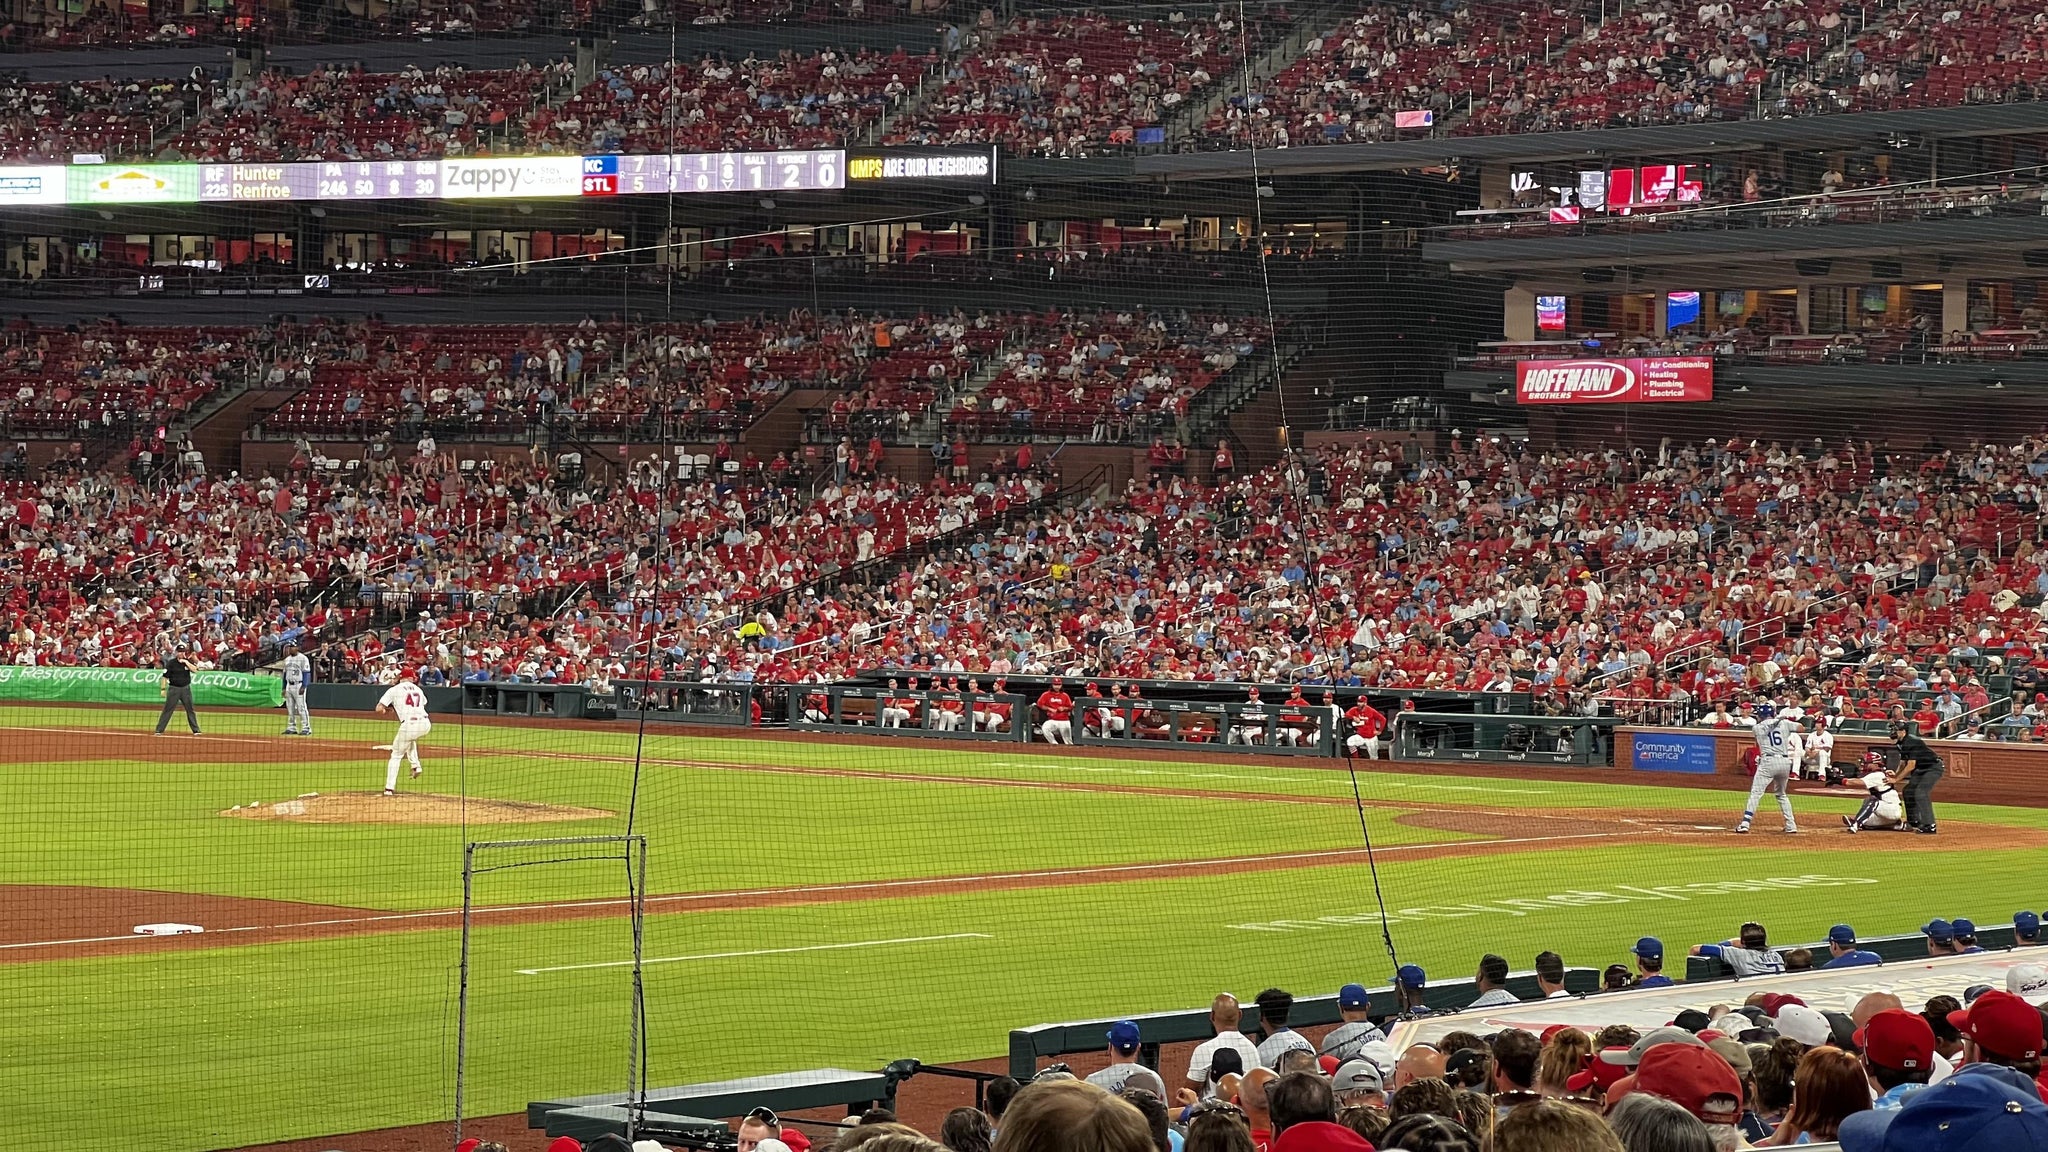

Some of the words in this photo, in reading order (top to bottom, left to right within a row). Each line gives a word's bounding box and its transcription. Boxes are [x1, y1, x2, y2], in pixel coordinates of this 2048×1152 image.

[584, 159, 603, 172] KC
[634, 156, 644, 172] 7
[664, 156, 681, 172] 11
[700, 156, 708, 171] 1
[744, 156, 766, 165] BALL
[777, 154, 807, 165] STRIKE
[818, 154, 836, 163] OUT
[206, 168, 224, 181] RF
[232, 166, 282, 181] Hunter
[326, 164, 342, 176] PA
[360, 164, 370, 176] H
[386, 163, 404, 176] HR
[416, 162, 436, 175] RBI
[652, 170, 659, 178] H
[685, 170, 690, 178] E
[723, 165, 733, 179] 8
[850, 158, 883, 178] UMPS
[883, 158, 904, 177] ARE
[905, 158, 927, 177] OUR
[927, 156, 988, 176] NEIGHBORS
[448, 166, 521, 192] Zappy
[697, 174, 708, 190] 0
[750, 166, 762, 188] 1
[784, 164, 800, 187] 2
[819, 164, 835, 187] 0
[202, 184, 228, 197] .225
[232, 182, 290, 198] Renfroe
[320, 180, 348, 196] 246
[355, 180, 374, 195] 50
[389, 179, 400, 194] 8
[415, 179, 434, 194] 30
[584, 178, 611, 191] STL
[633, 176, 644, 191] 5
[667, 176, 677, 190] 9
[1662, 361, 1710, 370] Conditioning
[1522, 367, 1615, 392] HOFFMANN
[1650, 371, 1678, 380] Heating
[1650, 380, 1684, 389] Plumbing
[1528, 392, 1572, 400] BROTHERS
[0, 668, 14, 682] g.
[20, 667, 129, 682] Restoration.
[132, 670, 252, 689] Couction.
[406, 693, 420, 707] 47
[1768, 731, 1782, 746] 16
[1635, 742, 1686, 754] Community
